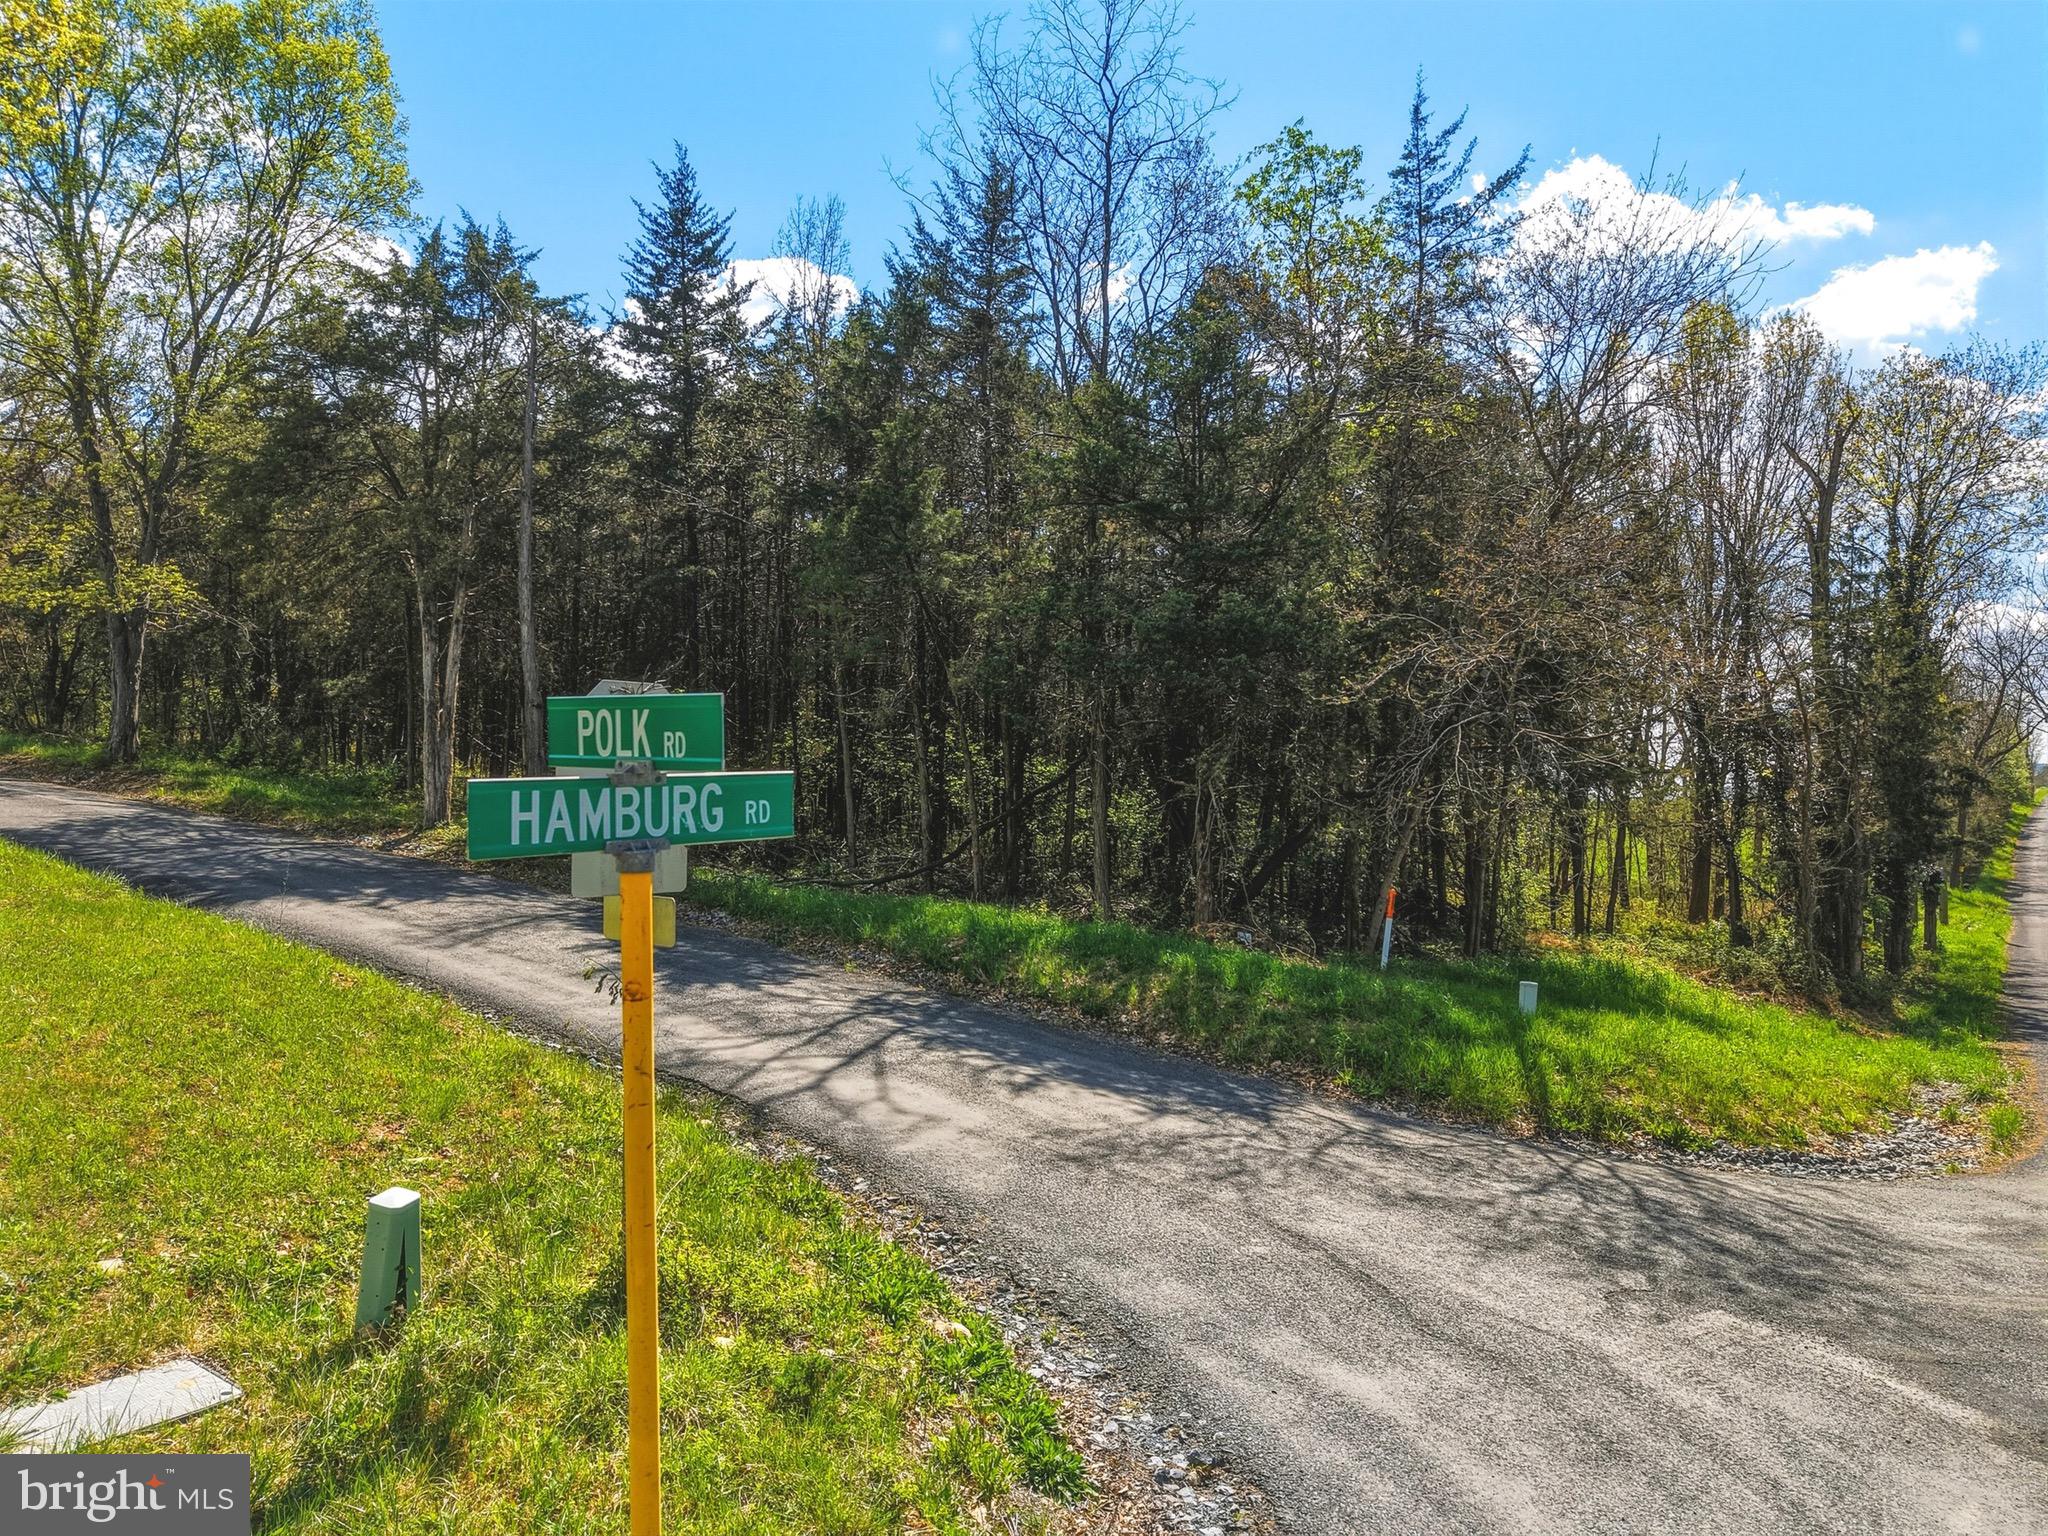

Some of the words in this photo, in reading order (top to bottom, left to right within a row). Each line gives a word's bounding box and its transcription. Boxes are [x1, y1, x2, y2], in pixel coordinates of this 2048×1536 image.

[577, 708, 651, 758] POLK
[663, 731, 687, 759] RD
[510, 782, 724, 846] HAMBURG
[745, 799, 771, 826] RD
